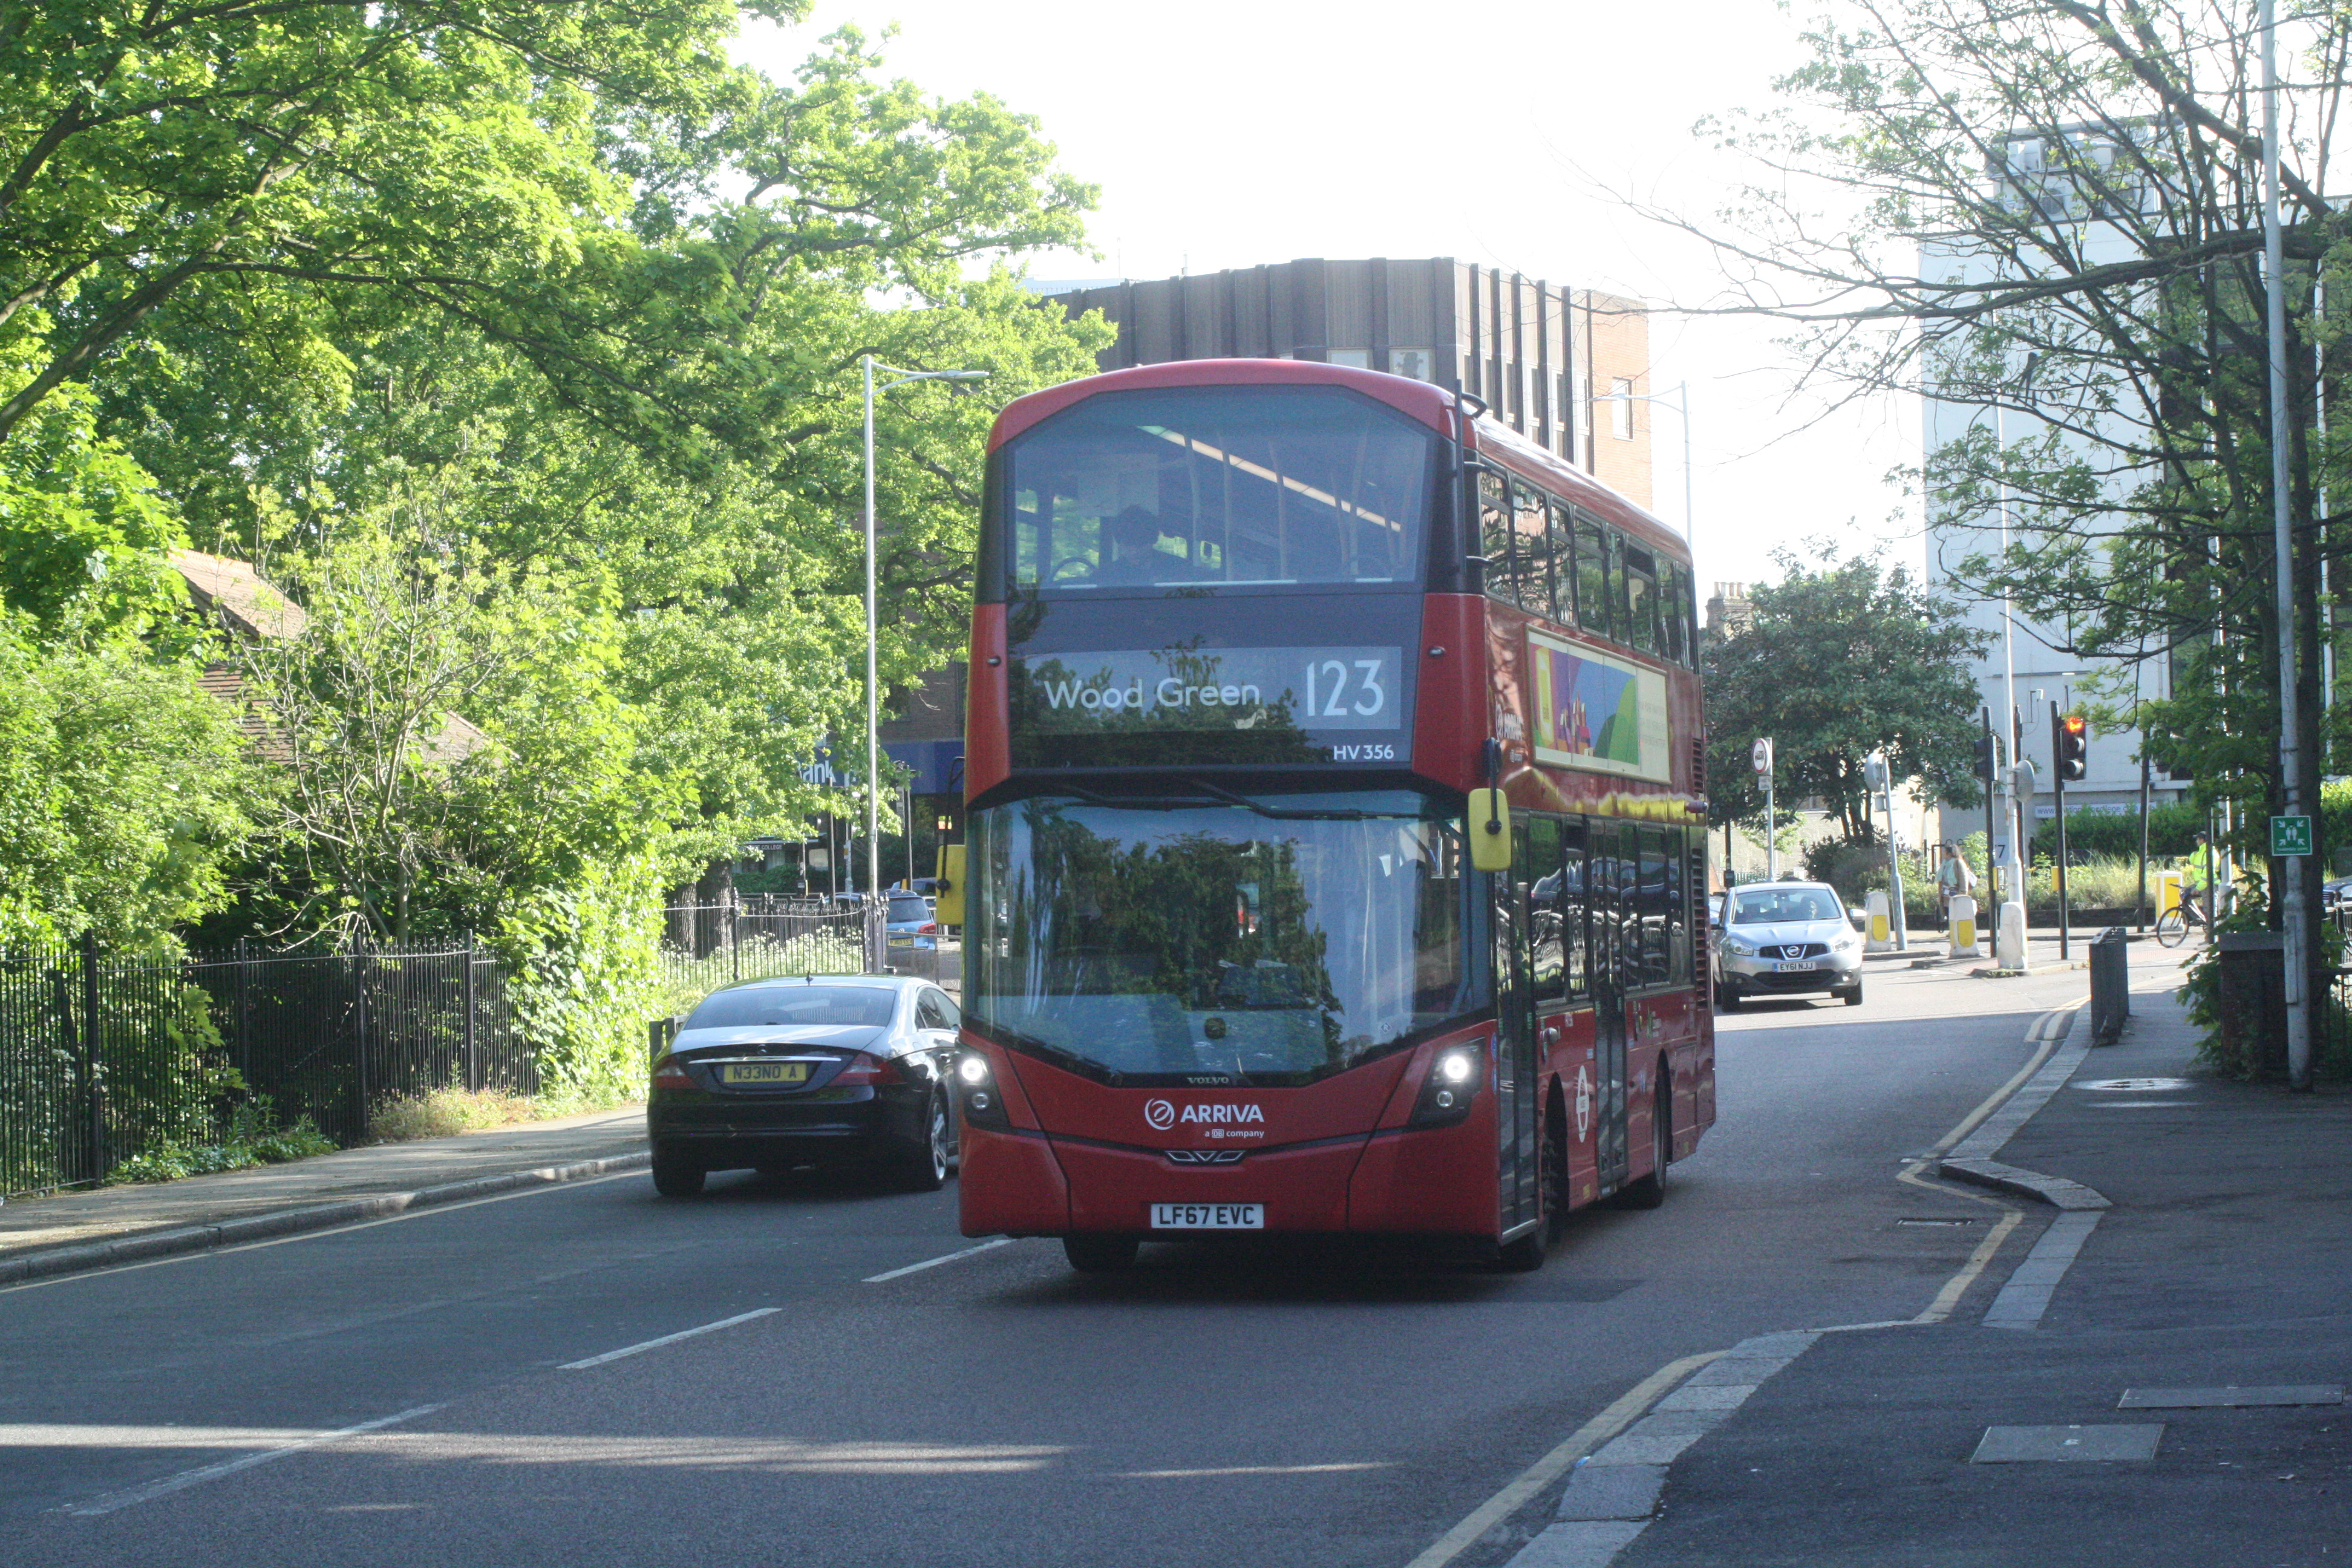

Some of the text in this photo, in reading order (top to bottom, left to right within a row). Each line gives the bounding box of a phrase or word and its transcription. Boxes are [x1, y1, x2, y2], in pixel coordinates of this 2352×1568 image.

[1044, 677, 1260, 709] Wood Green
[1306, 659, 1385, 717] 123
[1180, 1105, 1264, 1123] ARRIVA
[1213, 1129, 1223, 1138] DB
[1226, 1129, 1265, 1138] company
[1158, 1206, 1255, 1225] LF67 EVC
